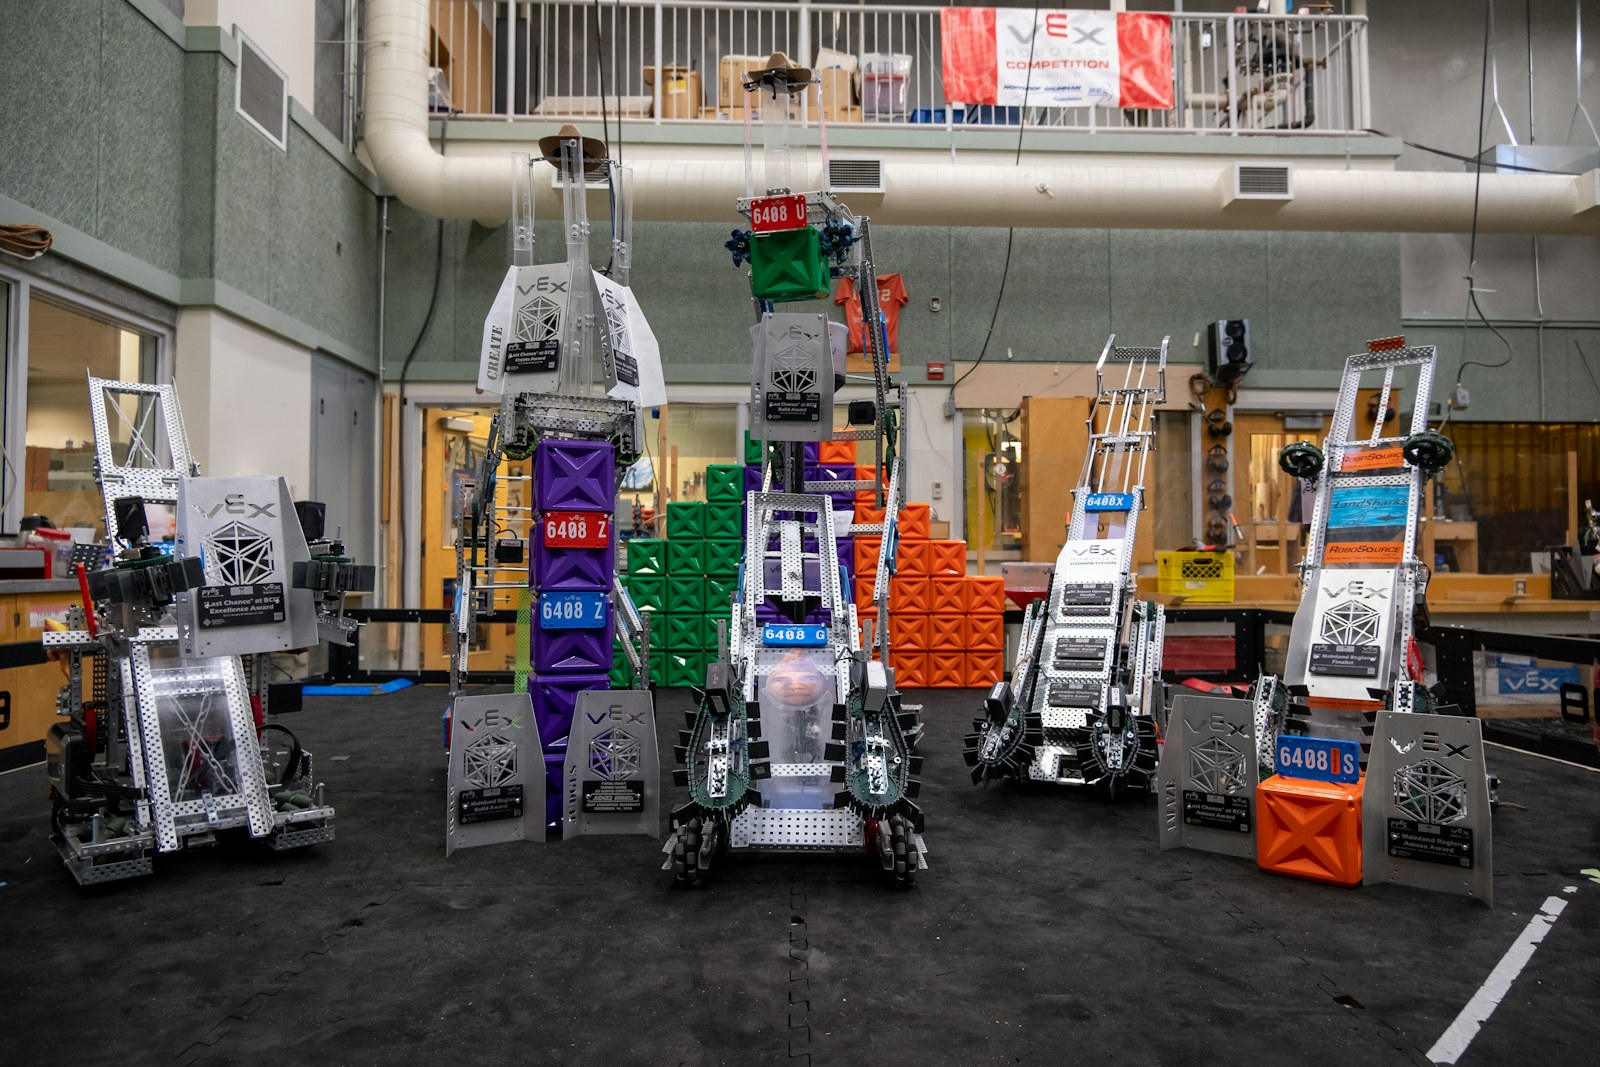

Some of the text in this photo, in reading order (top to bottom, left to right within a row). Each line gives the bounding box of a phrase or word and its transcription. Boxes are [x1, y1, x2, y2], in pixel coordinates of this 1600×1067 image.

[1006, 13, 1106, 46] VEX
[1006, 60, 1109, 69] COMPETITION
[753, 203, 805, 224] 6408 U
[517, 276, 568, 296] VEX
[768, 325, 821, 345] VEX
[487, 325, 503, 381] CREATE
[1343, 453, 1403, 462] ROBOSOURC
[192, 494, 277, 519] VEX
[1087, 497, 1124, 506] 6408X
[1334, 498, 1408, 508] LandSharks
[547, 521, 606, 539] 6408 Z
[1072, 545, 1116, 556] VEX
[1322, 581, 1389, 599] VEX
[210, 605, 249, 614] Excellence
[543, 601, 603, 619] 6408 Z
[765, 629, 825, 640] 6408 G
[1505, 671, 1559, 691] VEX
[460, 709, 523, 732] VEX
[585, 704, 646, 725] VEX
[1184, 712, 1250, 739] VEX
[1388, 731, 1473, 761] VEX
[1280, 746, 1328, 771] 6408
[1343, 753, 1354, 774] S
